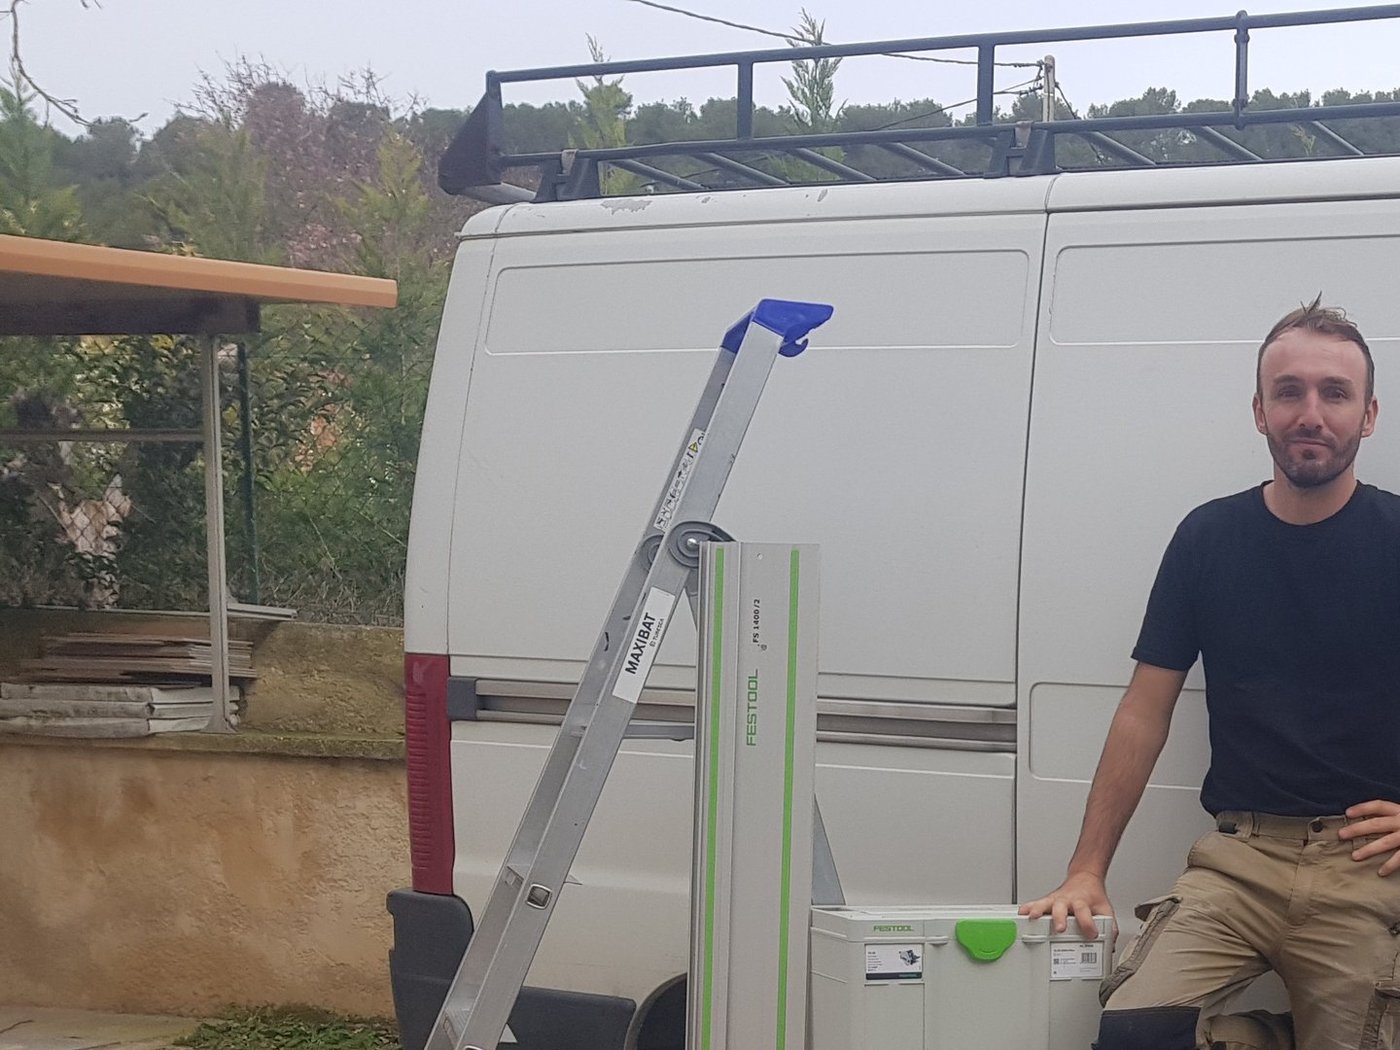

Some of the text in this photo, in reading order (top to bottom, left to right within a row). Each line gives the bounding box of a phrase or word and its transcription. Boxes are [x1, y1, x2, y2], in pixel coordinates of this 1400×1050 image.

[624, 612, 656, 674] MAXIBAT
[753, 632, 760, 643] FS
[746, 668, 758, 746] FESTOOL
